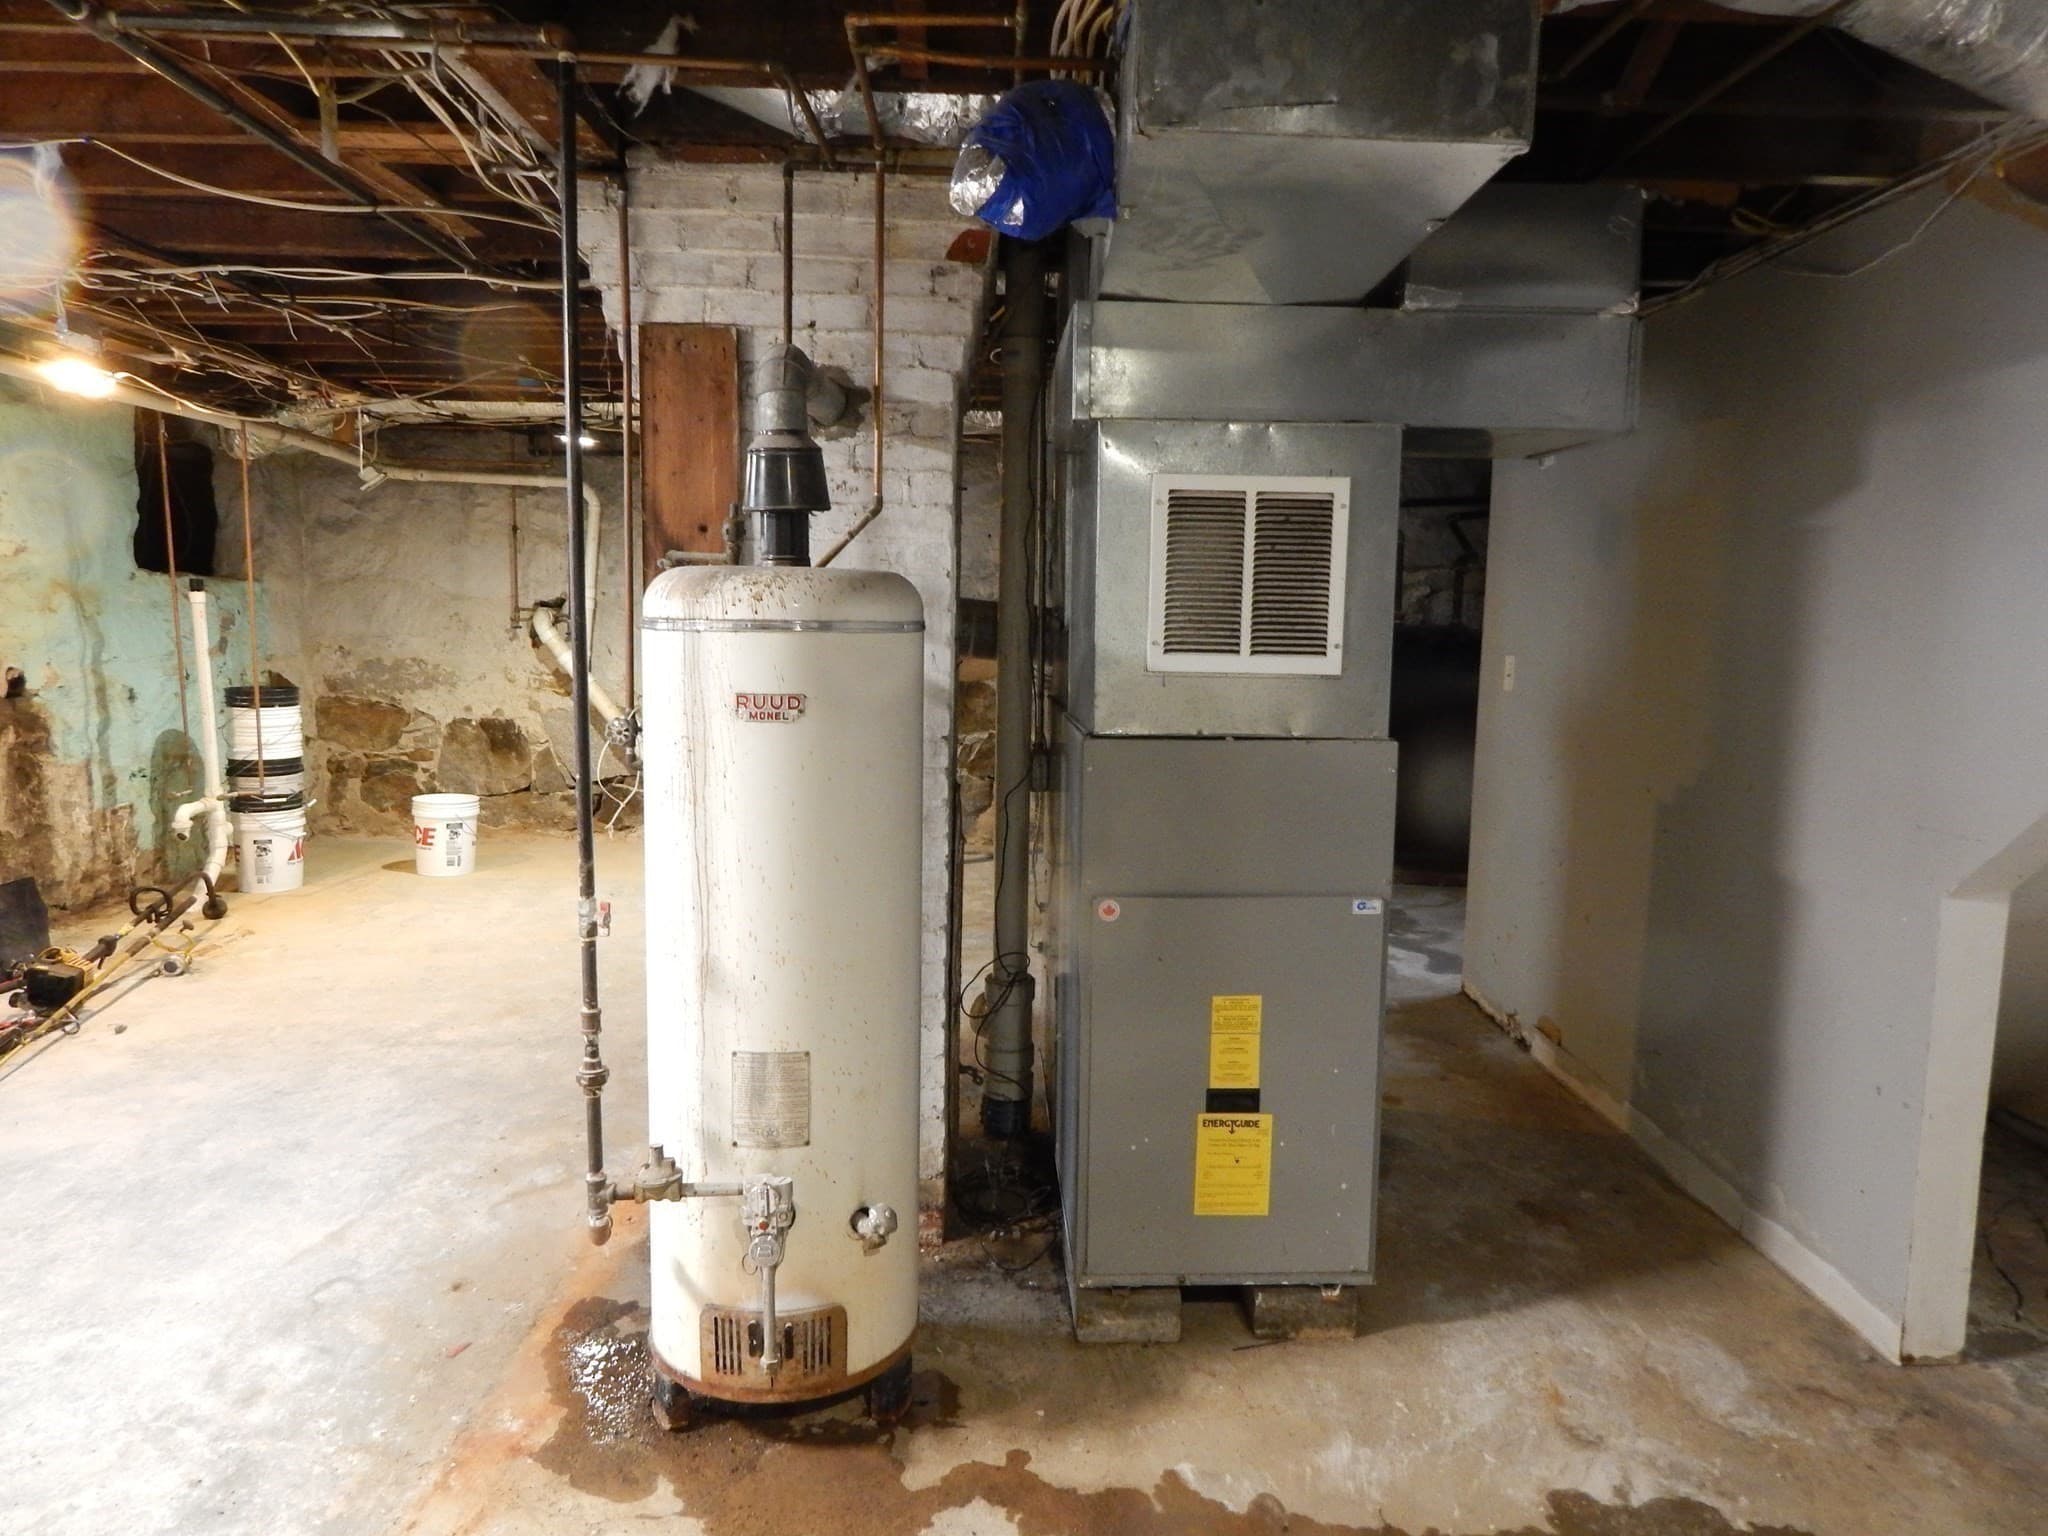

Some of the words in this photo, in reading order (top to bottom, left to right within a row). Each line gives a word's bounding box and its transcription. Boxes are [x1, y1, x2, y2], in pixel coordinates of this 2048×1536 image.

[736, 695, 801, 710] RUUD
[749, 712, 789, 720] MONEL
[1203, 1119, 1260, 1130] ENERGYGUIDE
